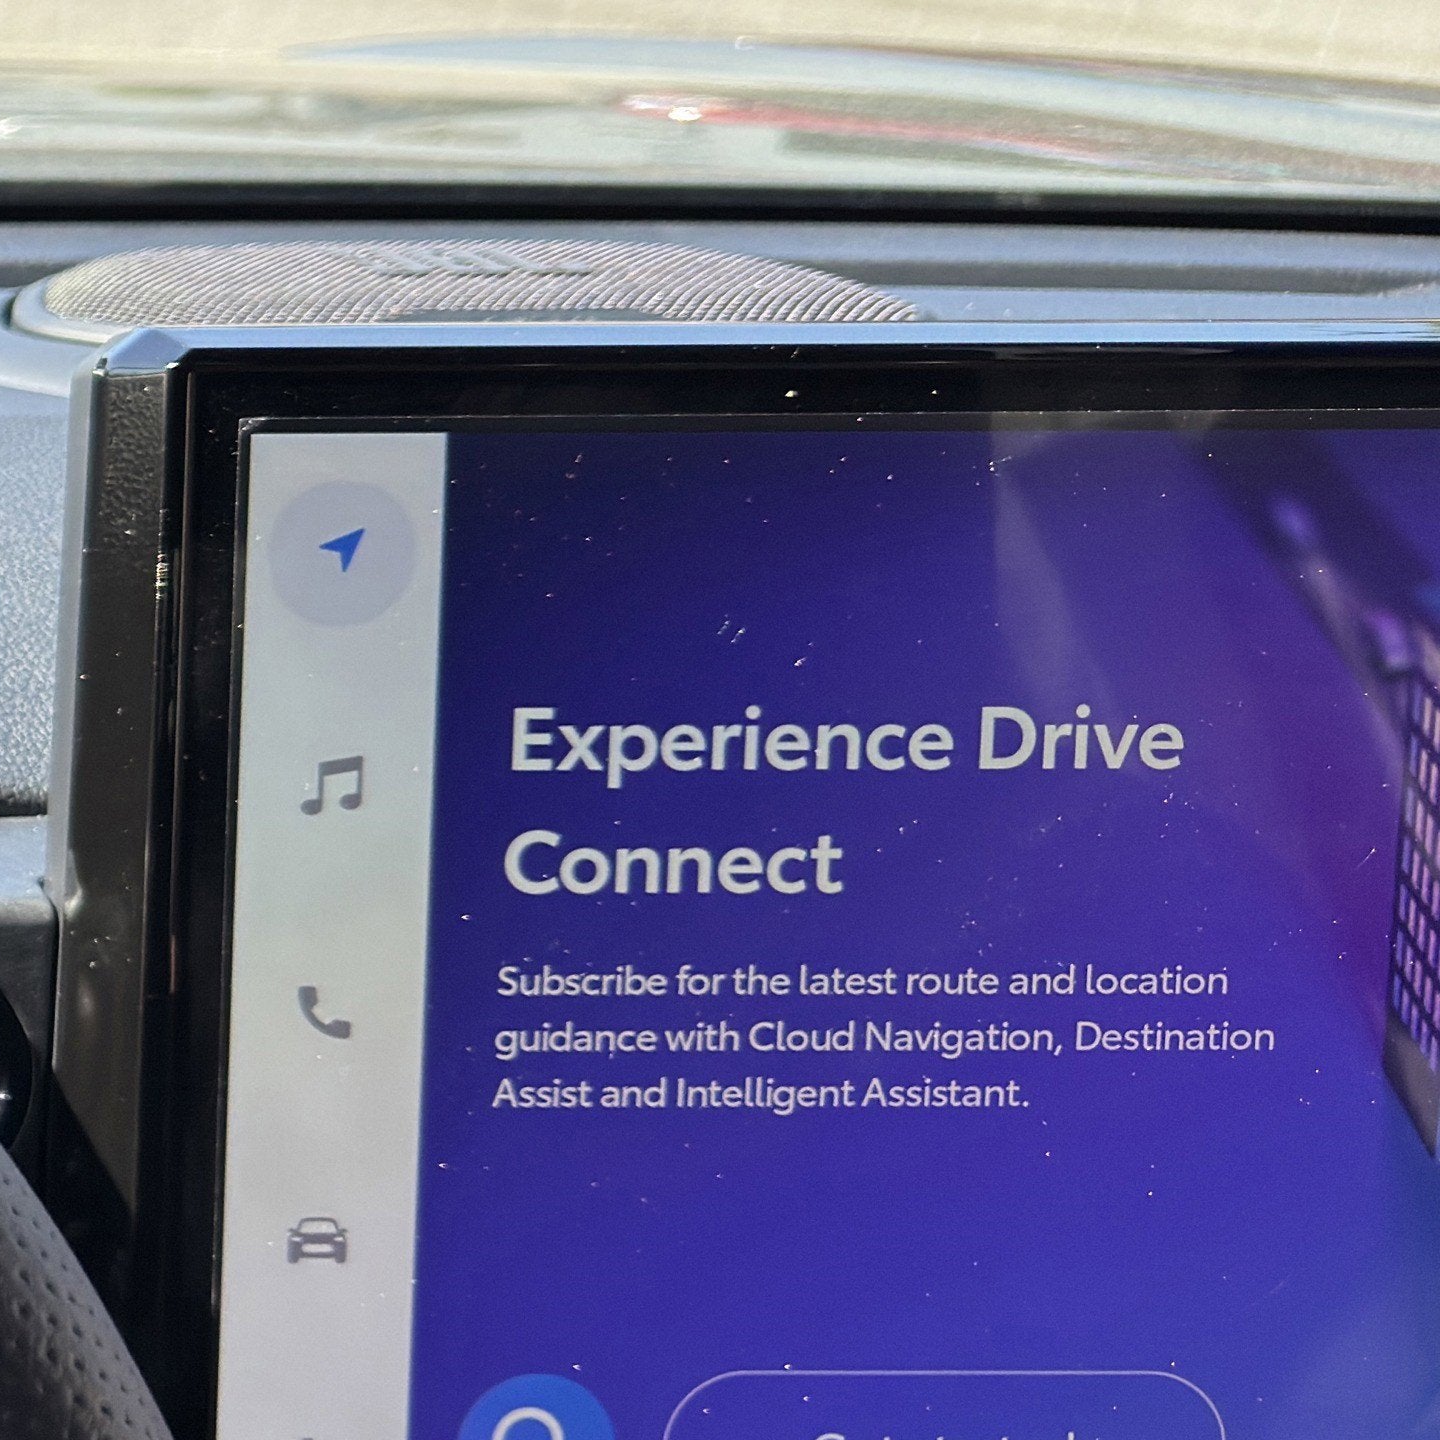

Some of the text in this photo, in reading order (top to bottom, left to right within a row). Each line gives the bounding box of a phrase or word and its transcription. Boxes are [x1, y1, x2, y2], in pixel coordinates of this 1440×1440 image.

[511, 705, 1184, 788] Experience Drive
[503, 830, 843, 896] Connect
[497, 964, 1229, 997] Subscribe for the latest route and location
[494, 1021, 1274, 1060] guidance with Cloud Navigation, Destination
[492, 1077, 1029, 1115] Assist and Intelligent Assistant.
